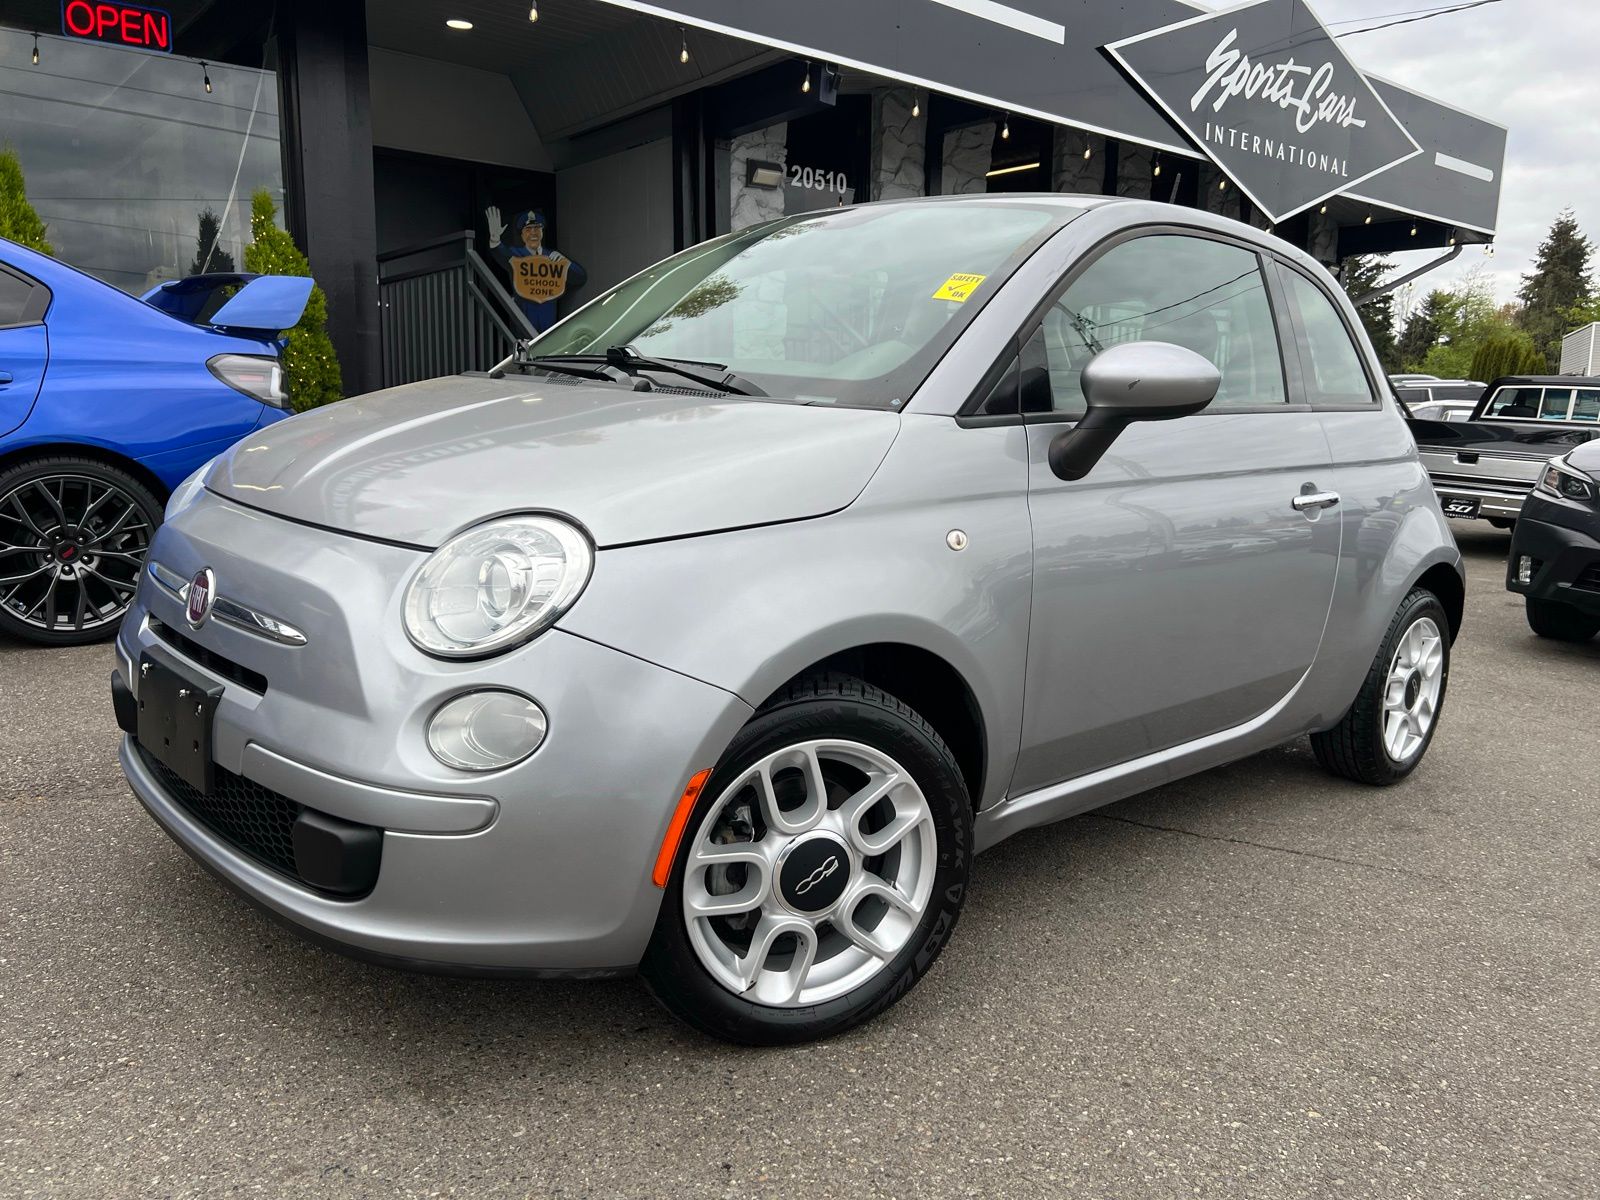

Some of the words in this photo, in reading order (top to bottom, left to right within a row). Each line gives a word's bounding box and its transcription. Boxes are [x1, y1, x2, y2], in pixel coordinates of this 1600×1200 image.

[66, 1, 167, 47] OPEN
[1190, 28, 1311, 113] Sports
[1295, 62, 1367, 134] Cars
[1205, 122, 1349, 178] INTERNATIONAL
[790, 164, 847, 194] 20510
[521, 262, 564, 279] SLOW
[524, 279, 560, 288] SCHOOL
[951, 275, 982, 283] SAFETY
[529, 287, 554, 296] ZONE
[191, 584, 208, 613] FIAT
